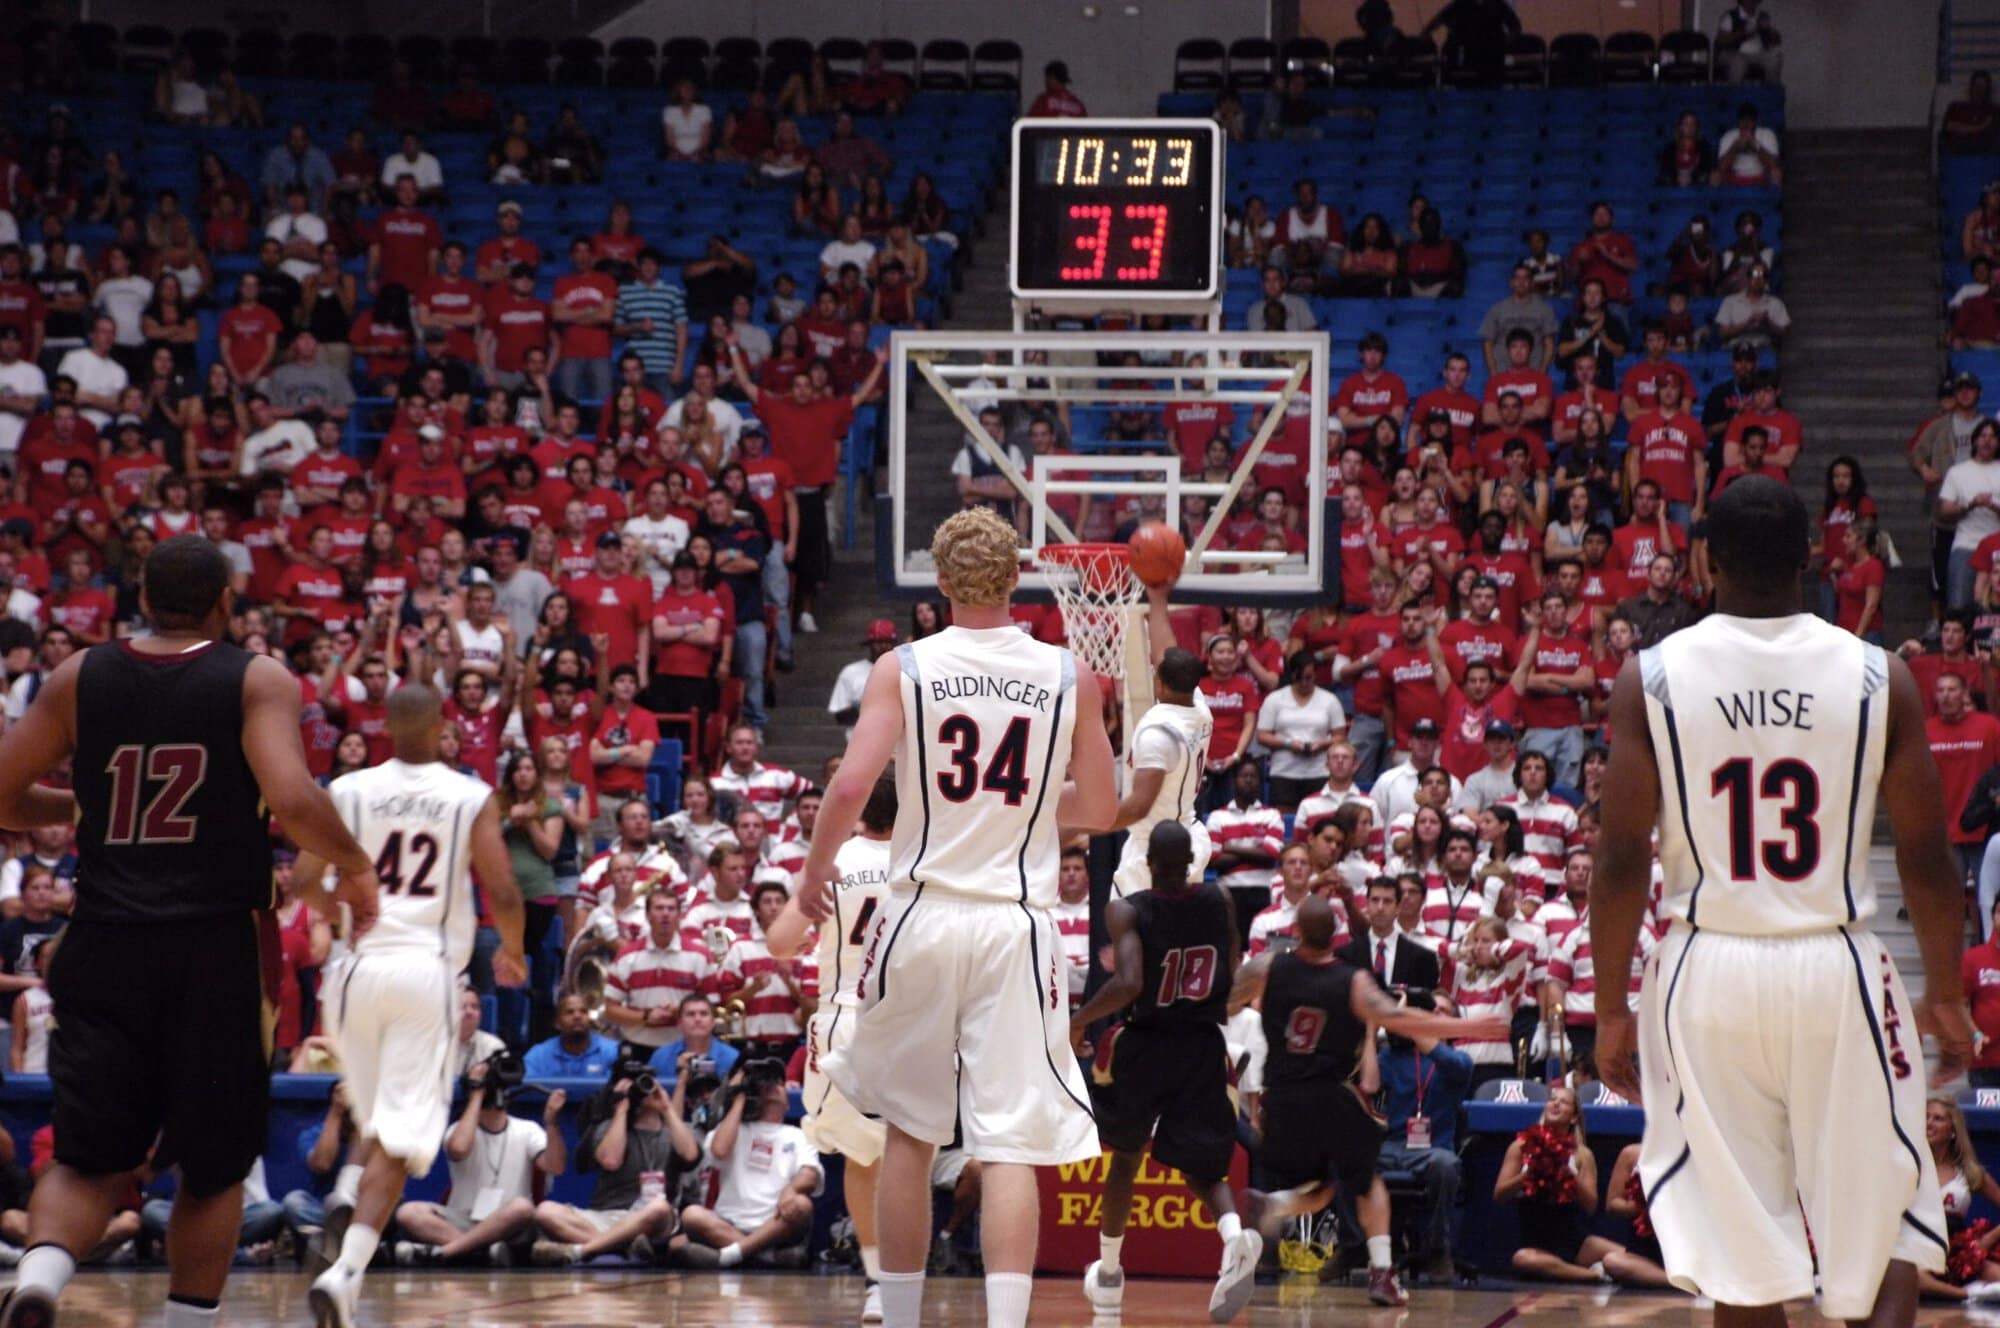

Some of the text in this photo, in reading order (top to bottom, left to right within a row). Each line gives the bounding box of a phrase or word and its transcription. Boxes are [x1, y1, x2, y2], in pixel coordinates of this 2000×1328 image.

[1056, 138, 1193, 187] 10:33
[1060, 204, 1169, 281] 33
[930, 675, 1050, 713] BUDINGER
[1715, 688, 1815, 731] WISE
[936, 713, 1032, 807] 34
[103, 743, 209, 845] 12
[1711, 757, 1822, 882] 13
[375, 828, 440, 897] 42
[1156, 945, 1218, 1008] 10
[1285, 1005, 1328, 1055] 9
